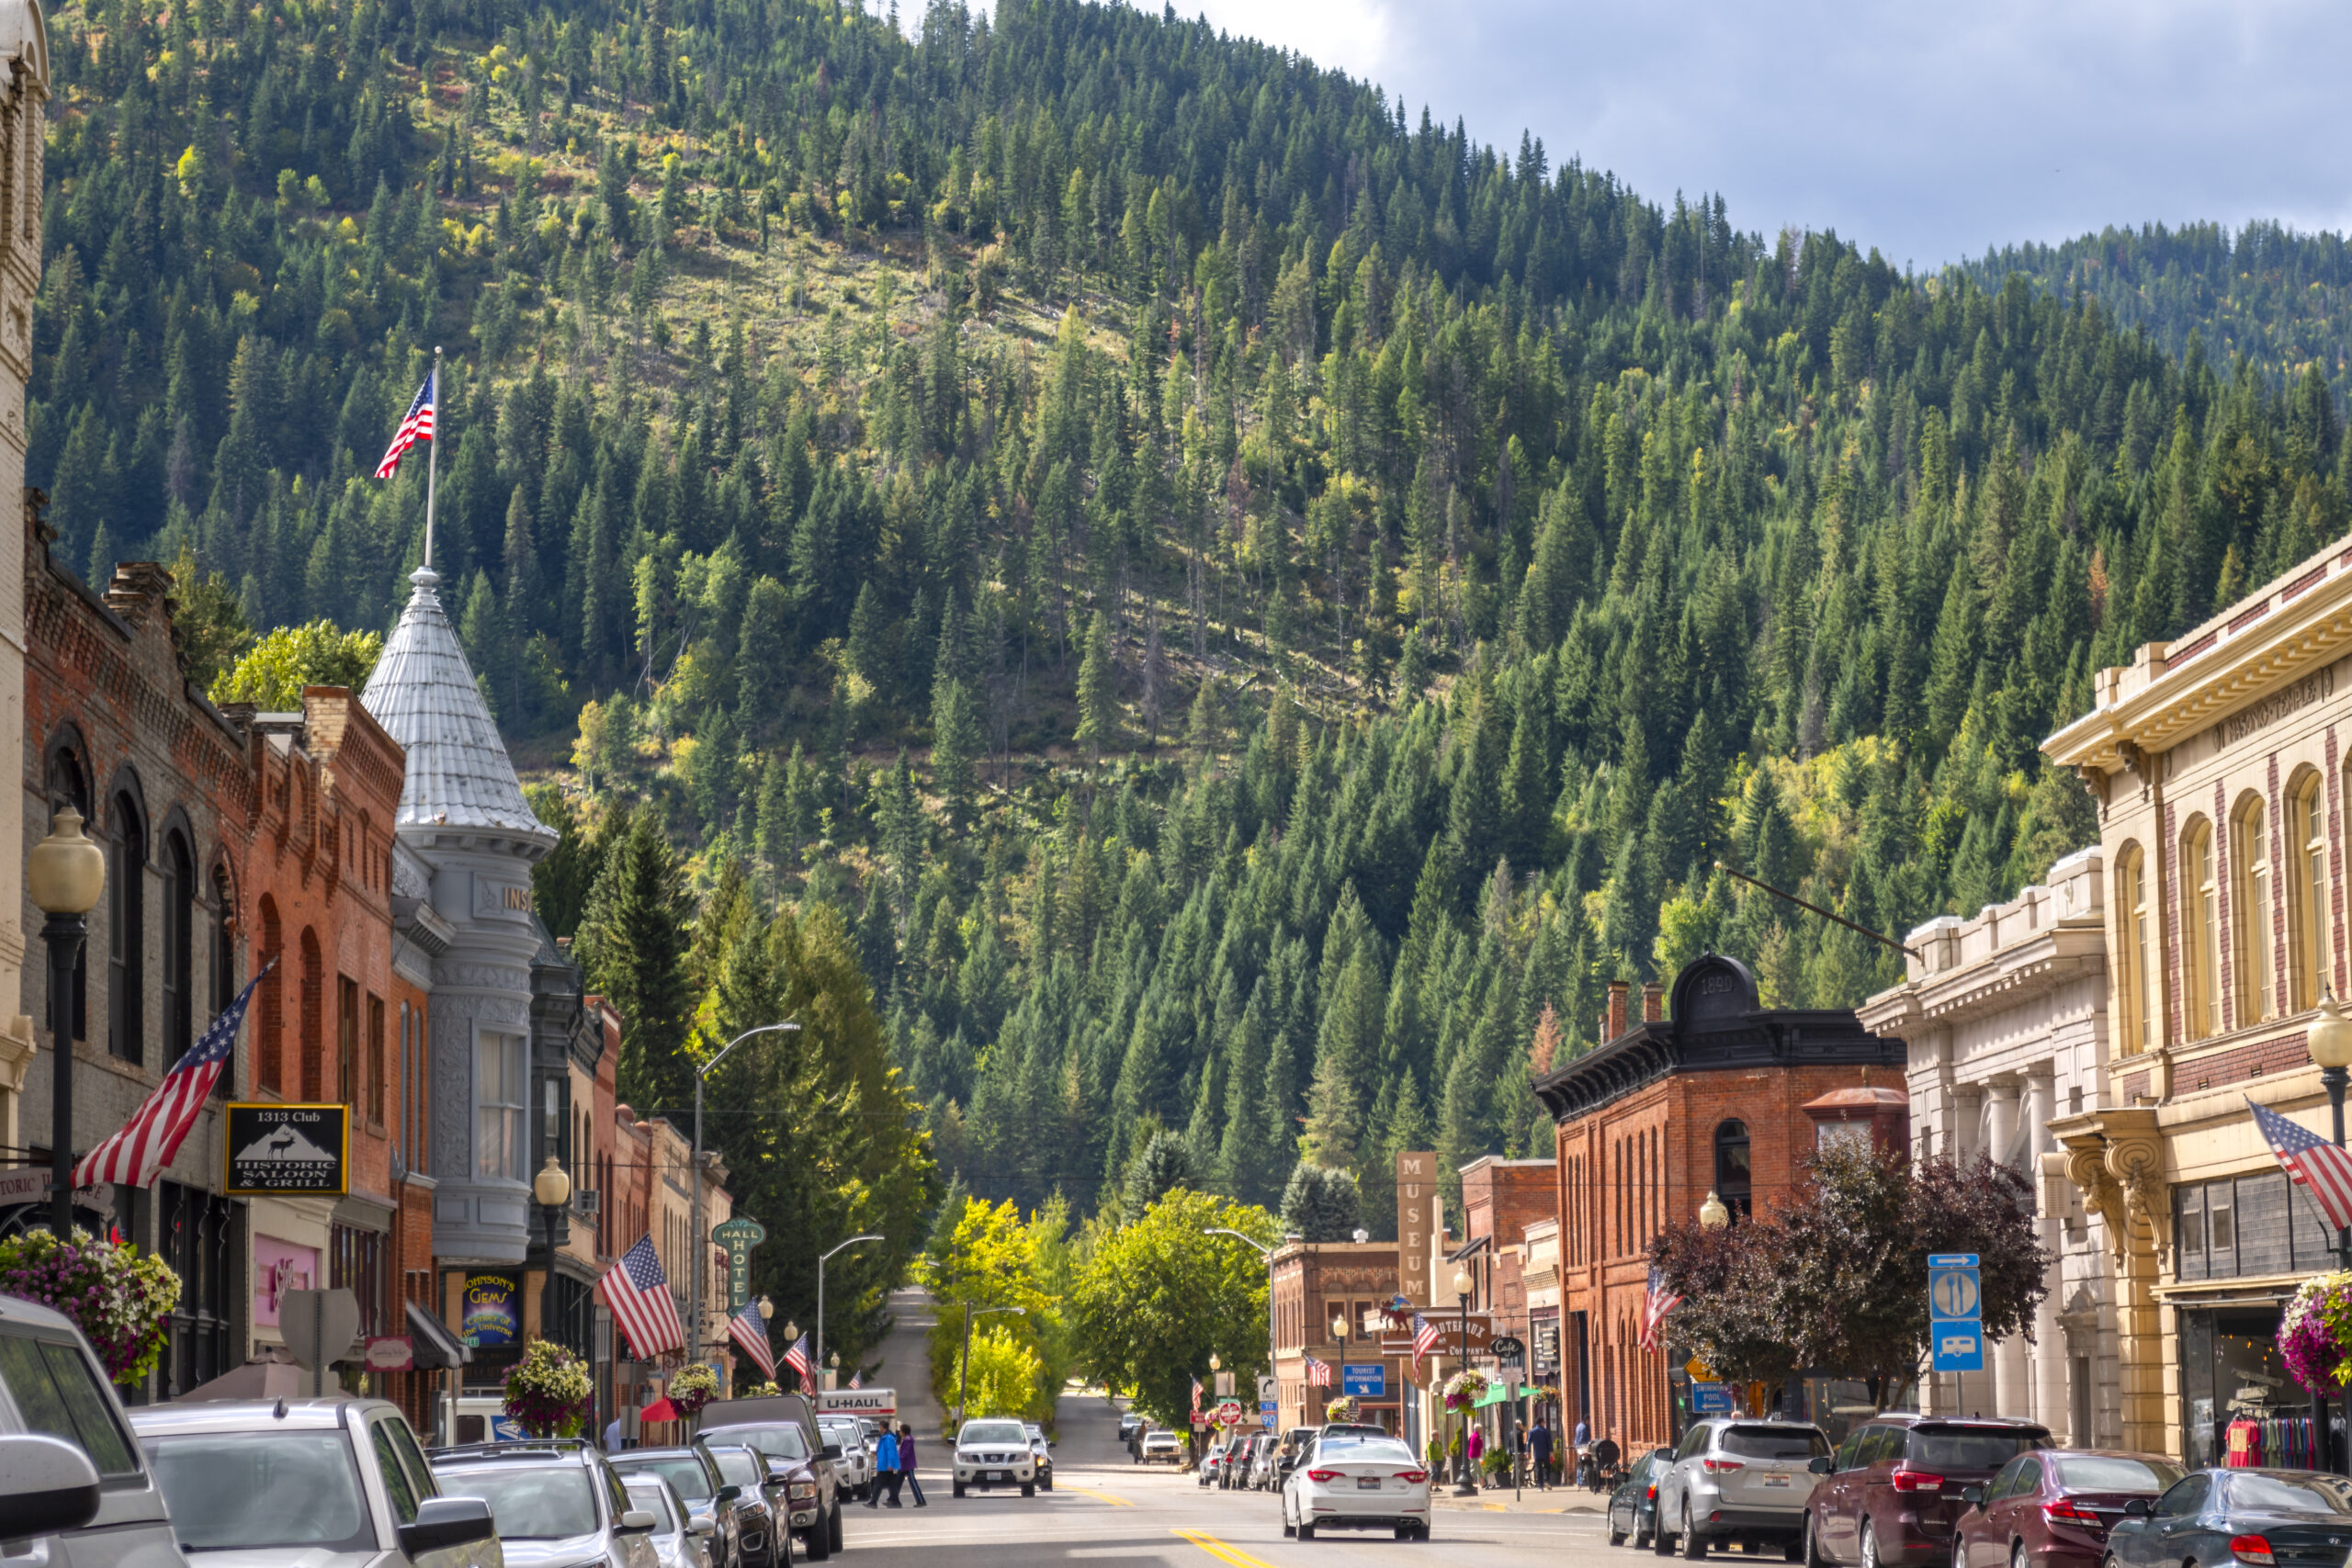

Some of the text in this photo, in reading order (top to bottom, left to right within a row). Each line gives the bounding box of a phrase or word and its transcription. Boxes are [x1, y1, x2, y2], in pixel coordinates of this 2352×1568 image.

[2274, 680, 2315, 719] TEMPLE
[1702, 976, 1733, 995] 1890
[258, 1112, 320, 1122] 1313 Club
[1403, 1159, 1424, 1296] MUSEUM
[722, 1231, 758, 1239] HALL
[733, 1240, 745, 1306] HOTEL
[463, 1275, 514, 1292] JOHNSON'S
[467, 1314, 498, 1325] Center
[479, 1324, 513, 1338] Universe
[828, 1399, 882, 1408] U-HAUL
[1262, 1416, 1276, 1425] 90
